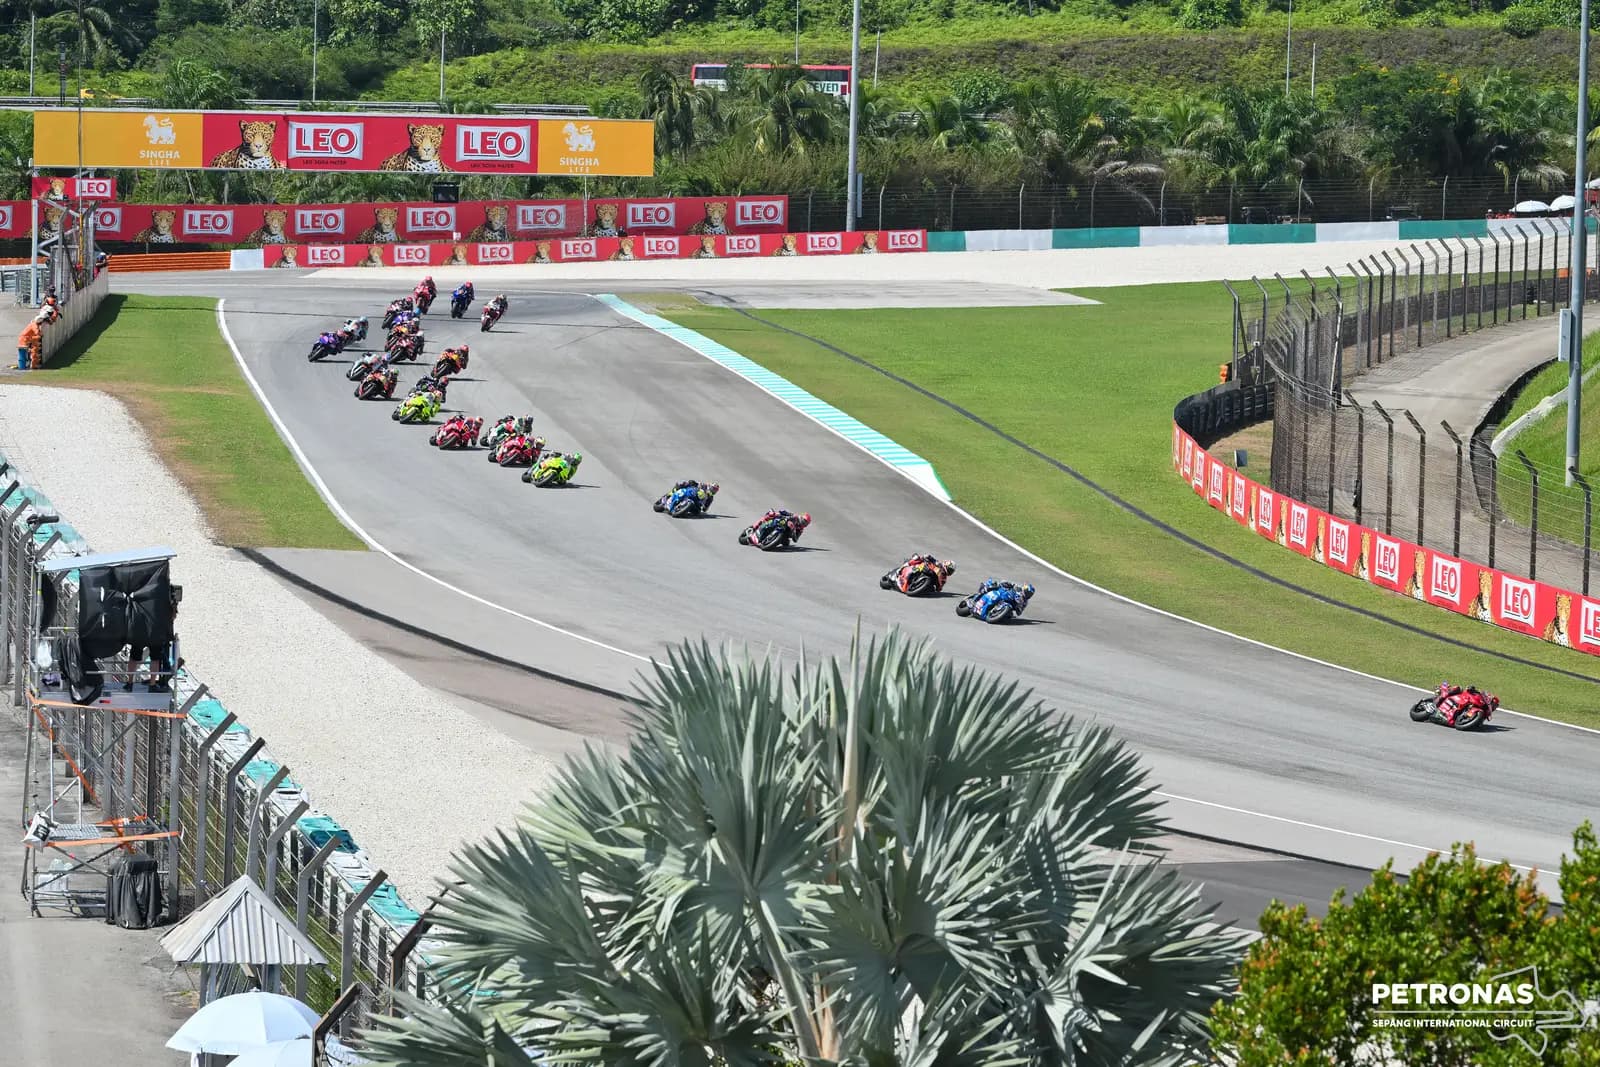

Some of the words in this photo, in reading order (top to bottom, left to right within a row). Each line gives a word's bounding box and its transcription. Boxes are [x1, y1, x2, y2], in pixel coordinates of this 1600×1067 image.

[295, 128, 358, 154] LEO
[463, 131, 525, 157] LEO
[139, 150, 181, 159] SINGHA
[559, 156, 600, 166] SINGHA
[300, 212, 341, 230] LEO
[411, 209, 451, 228] LEO
[521, 207, 562, 226] LEO
[631, 205, 672, 224] LEO
[740, 203, 780, 222] LEO
[187, 213, 229, 231] LEO
[647, 240, 676, 252] LEO
[728, 237, 757, 250] LEO
[810, 236, 838, 248] LEO
[891, 234, 919, 246] LEO
[311, 248, 341, 261] LEO
[396, 248, 427, 261] LEO
[481, 246, 510, 259] LEO
[564, 243, 593, 256] LEO
[1292, 509, 1306, 542] LEO
[1331, 522, 1346, 558] LEO
[1377, 541, 1397, 577] LEO
[1434, 560, 1458, 597] LEO
[1504, 582, 1534, 619] LEO
[1584, 606, 1600, 642] LE
